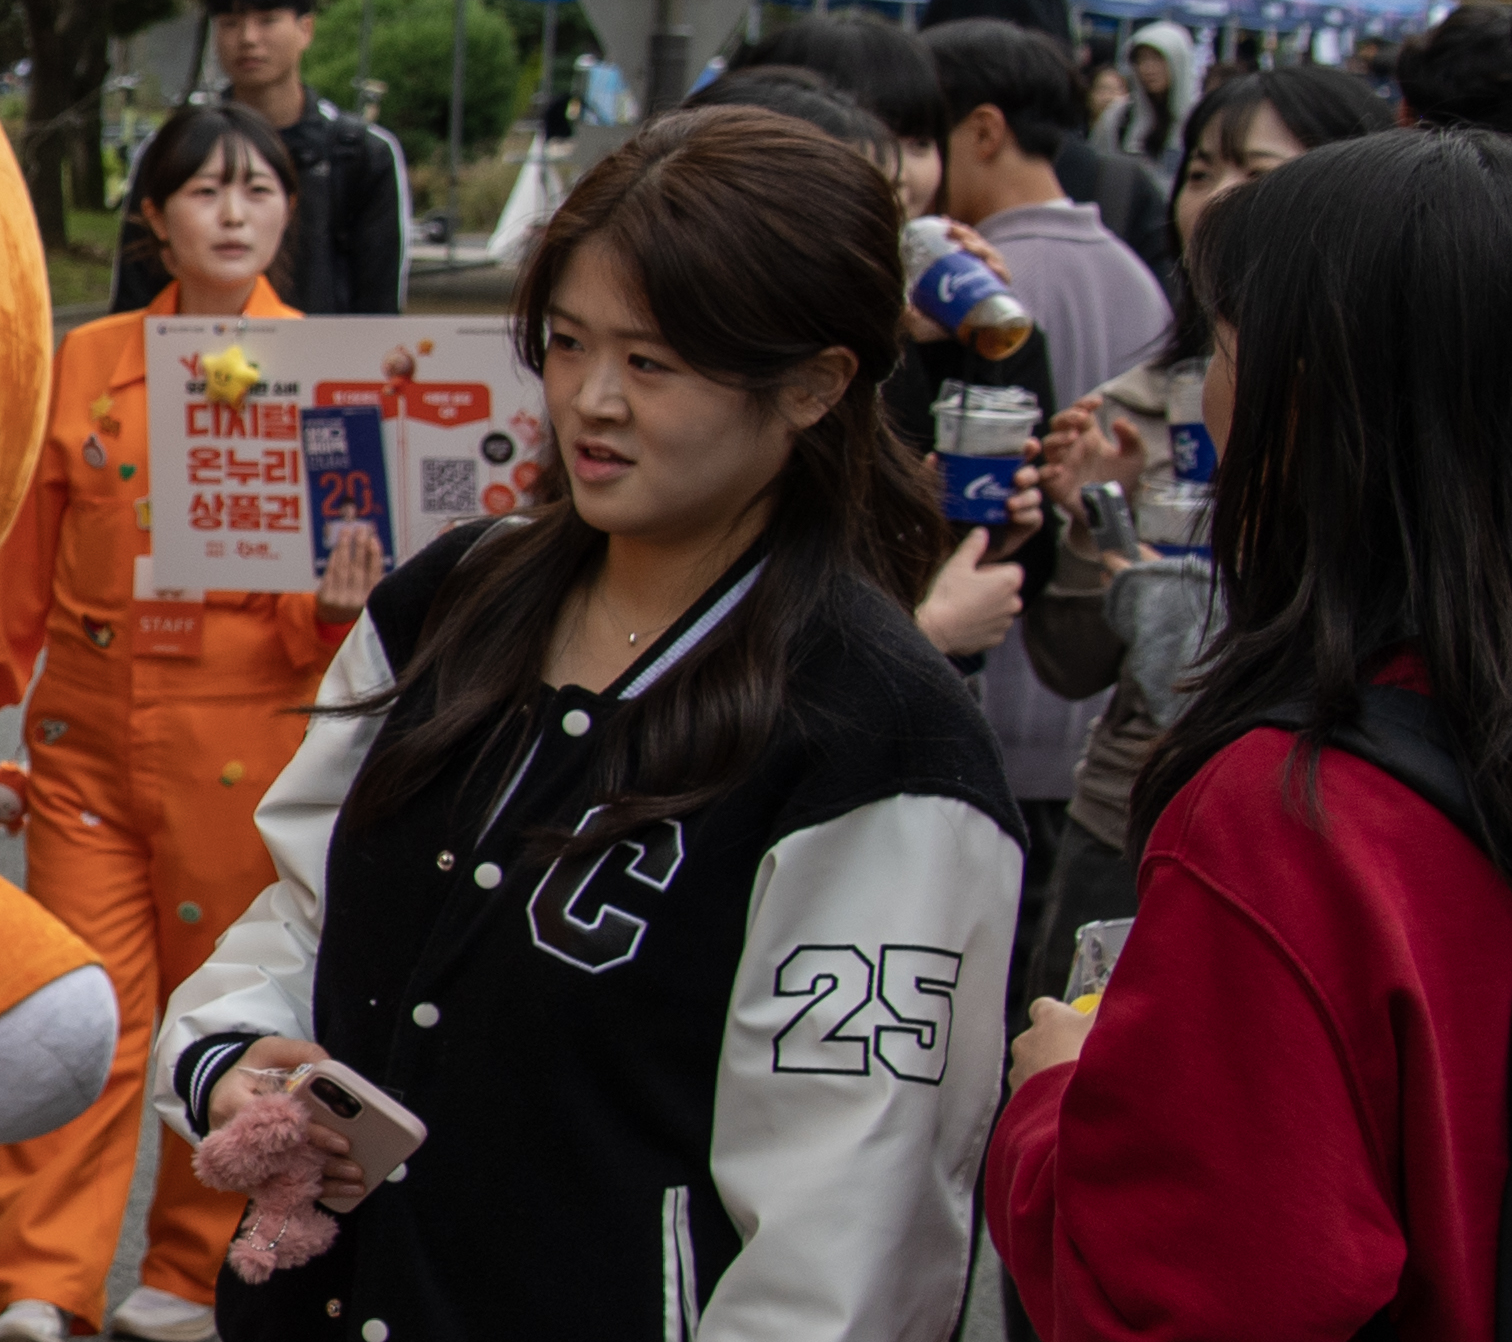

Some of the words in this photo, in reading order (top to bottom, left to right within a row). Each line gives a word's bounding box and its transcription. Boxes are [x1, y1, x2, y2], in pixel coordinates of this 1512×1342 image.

[185, 402, 299, 439] 디지털
[187, 446, 300, 487] 온누리
[188, 493, 301, 533] 상품권
[526, 803, 684, 973] C
[772, 944, 964, 1087] 25
